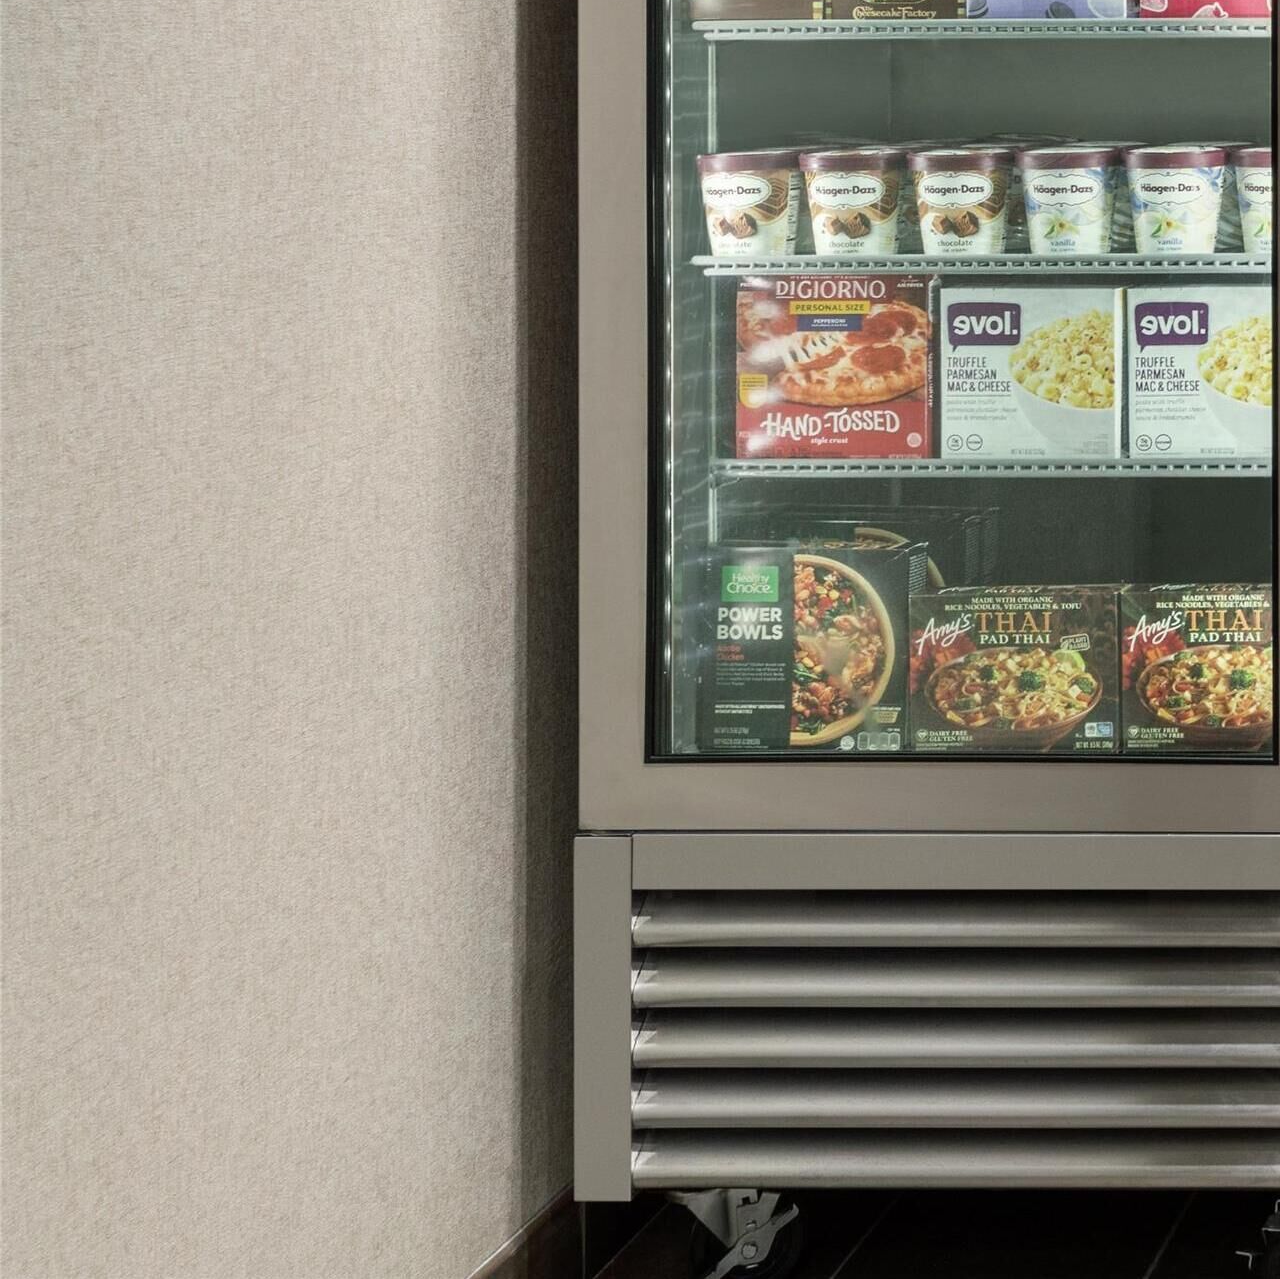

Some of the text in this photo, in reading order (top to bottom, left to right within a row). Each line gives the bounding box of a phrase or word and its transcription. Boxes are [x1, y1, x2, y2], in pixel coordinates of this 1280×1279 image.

[853, 6, 937, 19] Cheesecake Factory
[947, 357, 987, 368] TRUFFLE
[947, 370, 997, 380] PARMESAN
[947, 381, 1012, 392] MAC & CHEESE
[760, 408, 900, 440] HAND-TOSSED
[718, 607, 782, 622] POWER
[974, 612, 1053, 633] THAI
[717, 625, 783, 640] BOWLS
[915, 613, 972, 655] Amy's
[980, 634, 1050, 644] PAD THAI
